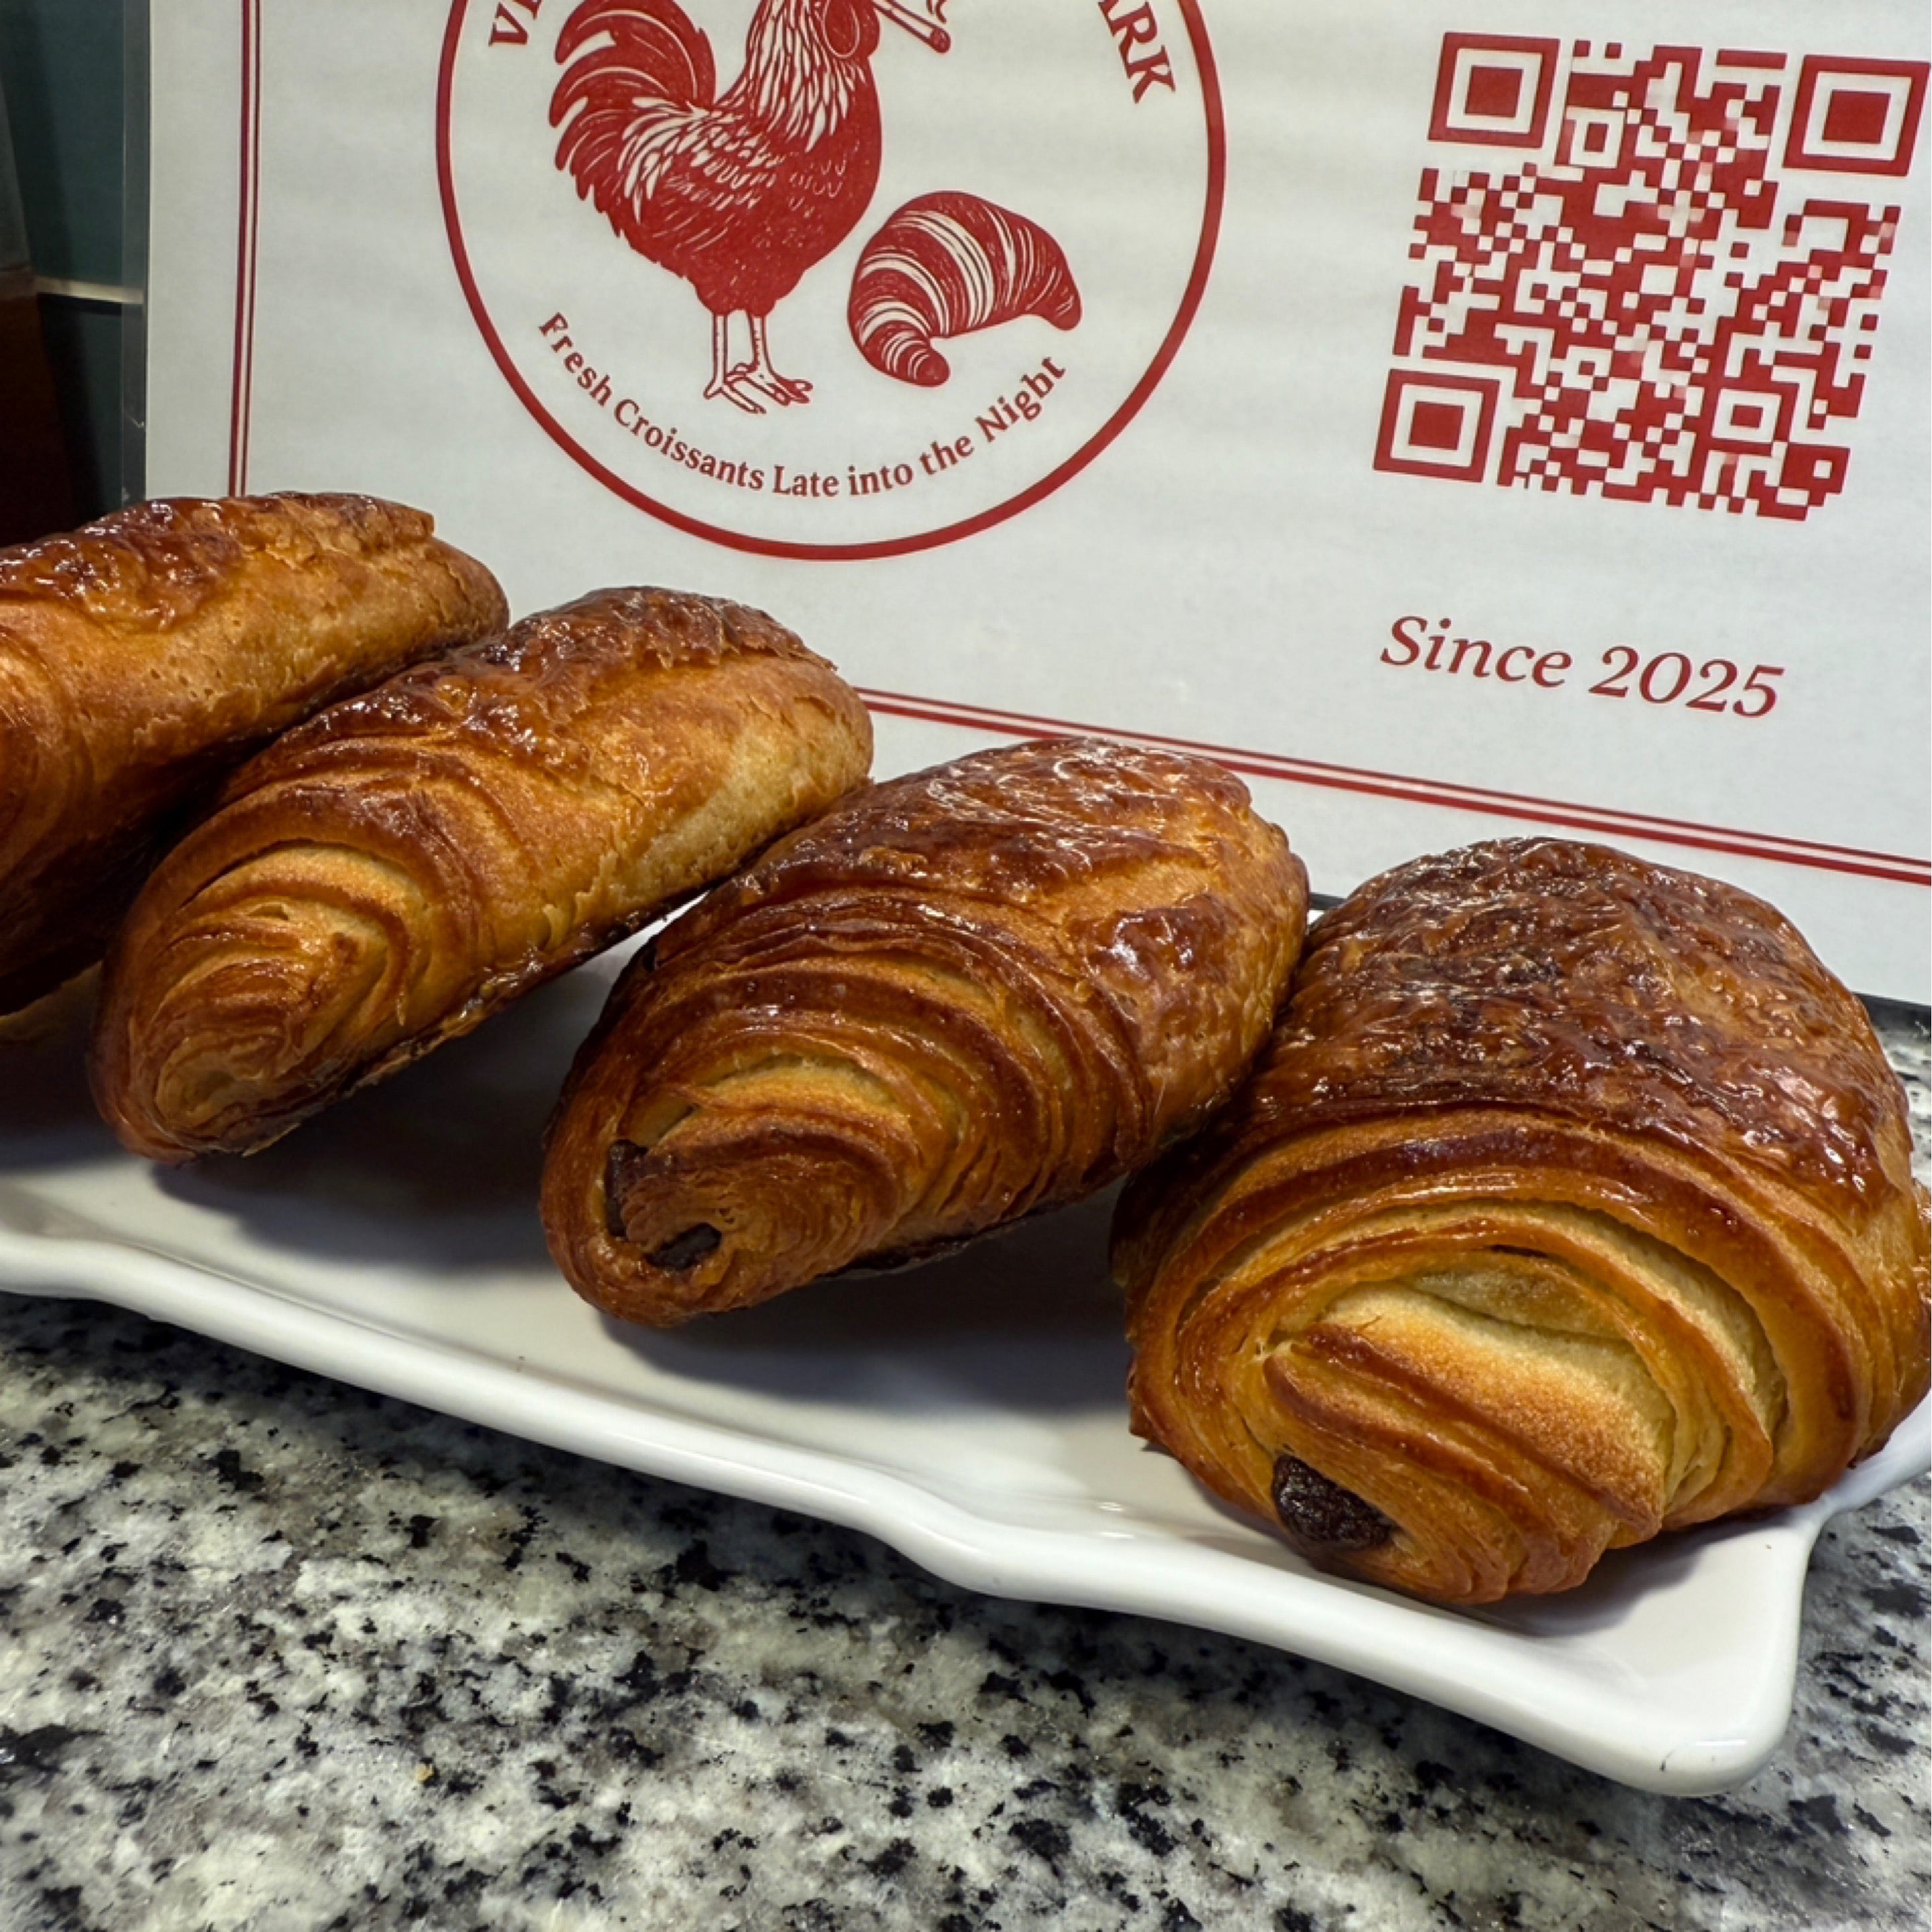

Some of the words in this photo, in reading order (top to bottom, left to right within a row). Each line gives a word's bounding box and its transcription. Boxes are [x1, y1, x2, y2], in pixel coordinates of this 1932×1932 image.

[1098, 0, 1175, 103] RK
[539, 312, 612, 407] Fresh
[614, 398, 765, 491] Croissants
[772, 464, 839, 497] Late
[847, 464, 914, 496] into
[919, 435, 975, 475] the
[975, 356, 1066, 443] Night
[1380, 615, 1573, 688] Since
[1588, 645, 1785, 718] 2025
